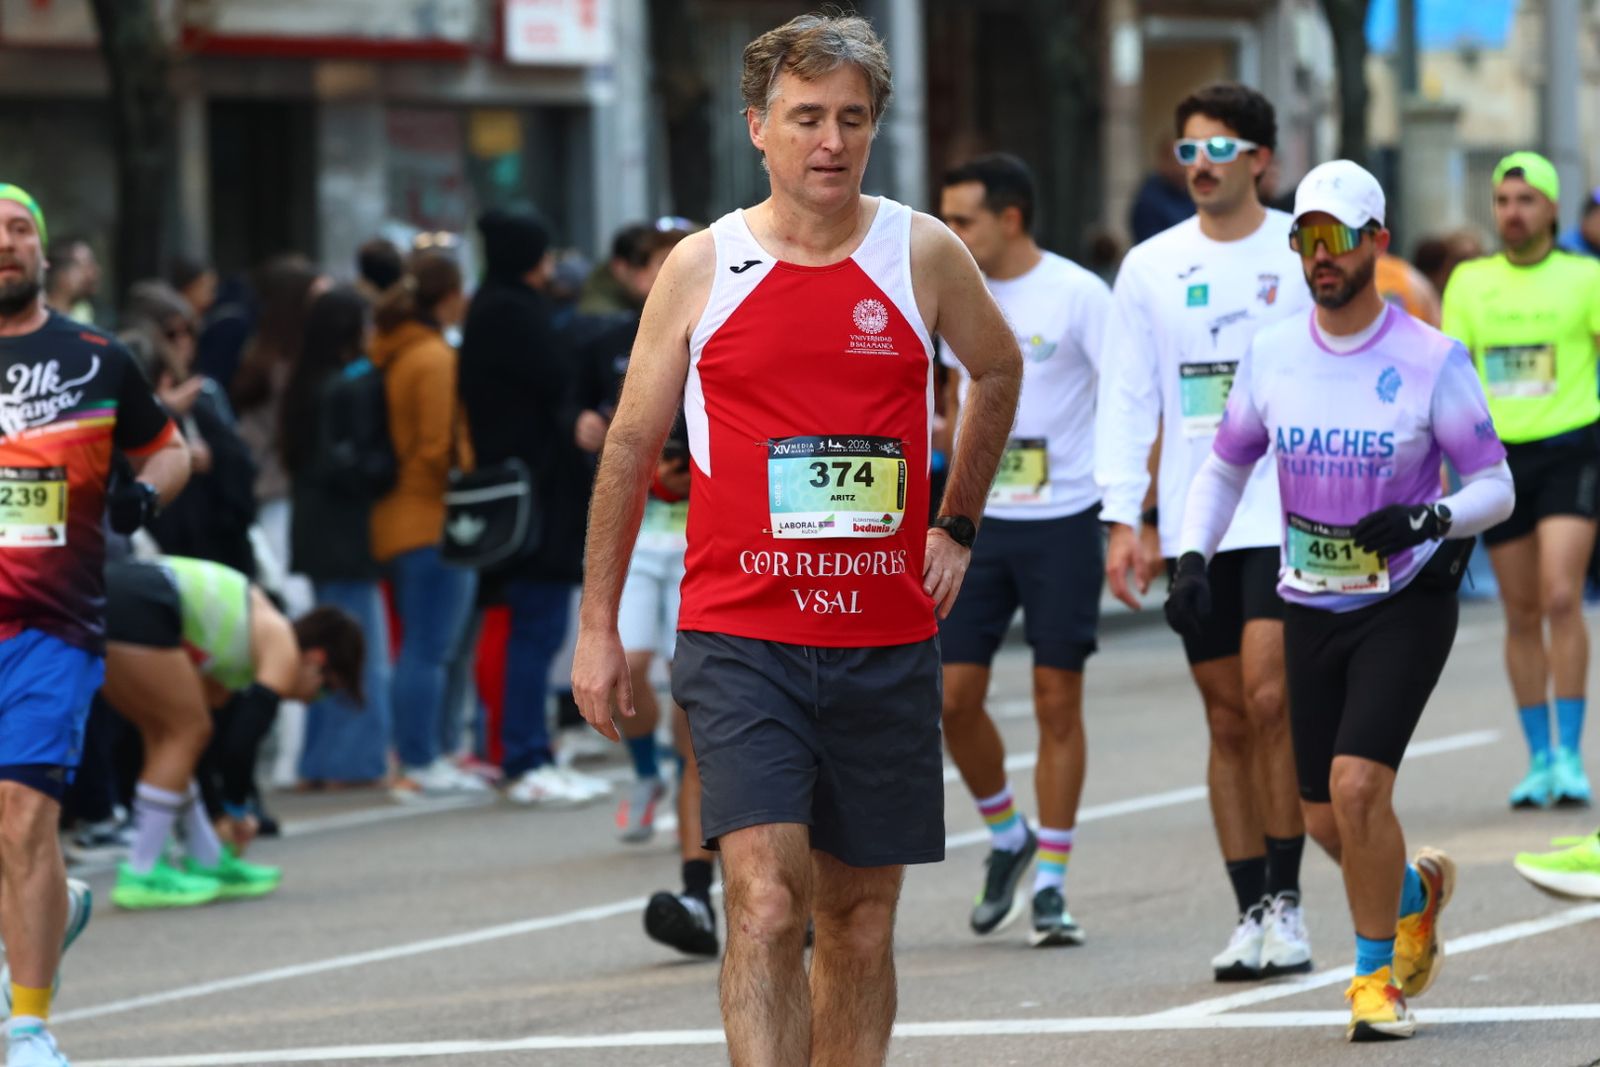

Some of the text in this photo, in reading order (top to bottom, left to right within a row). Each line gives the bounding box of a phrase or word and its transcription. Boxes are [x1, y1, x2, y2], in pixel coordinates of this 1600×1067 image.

[773, 443, 791, 455] XIV
[791, 442, 814, 450] MEDIA
[847, 438, 871, 450] 2026
[1276, 426, 1395, 458] APACHES
[809, 461, 875, 488] 374
[830, 494, 856, 502] ARITZ
[779, 520, 817, 530] LABORAL
[739, 549, 907, 577] CORREDORES
[1308, 540, 1353, 562] 461
[790, 588, 863, 614] VSAL
